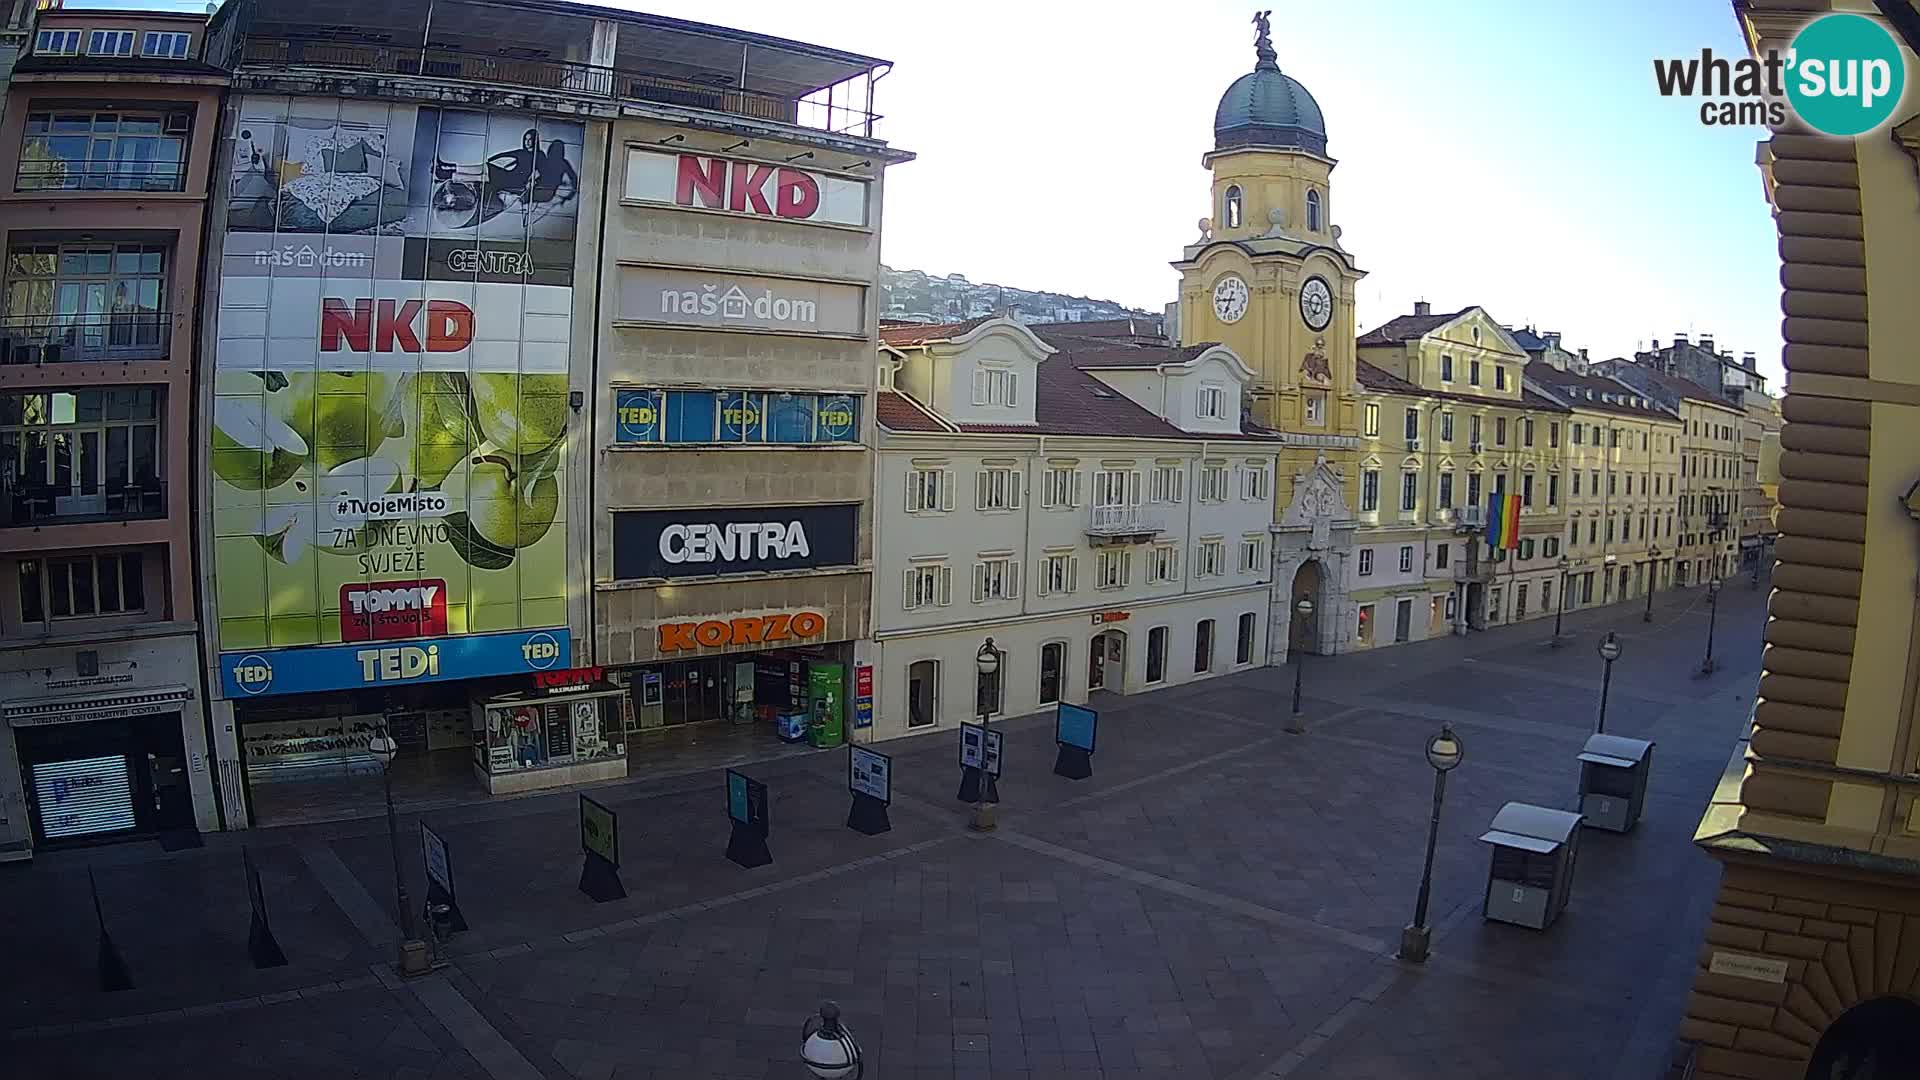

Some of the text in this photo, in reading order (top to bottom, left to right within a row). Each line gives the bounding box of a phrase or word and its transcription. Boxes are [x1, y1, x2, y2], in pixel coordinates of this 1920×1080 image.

[676, 155, 820, 219] NKD
[255, 245, 365, 268] naš dom
[447, 248, 535, 276] CENTRA
[660, 285, 816, 322] naš dom
[320, 297, 476, 353] NKD
[618, 407, 657, 424] TEDi
[723, 408, 759, 426] TEDi
[819, 408, 853, 426] TEDi
[337, 495, 446, 517] #TvojeMisto
[333, 523, 450, 548] ZA DNEVNO
[659, 520, 810, 563] CENTRA
[359, 549, 427, 575] SVJEŽE
[348, 585, 438, 614] TOMMY
[658, 611, 825, 653] KORZO
[521, 643, 559, 660] TEDi
[233, 664, 273, 684] TEDi
[357, 646, 440, 683] TEDi
[549, 684, 590, 694] MAXIMARKET
[131, 704, 162, 715] CENTAR
